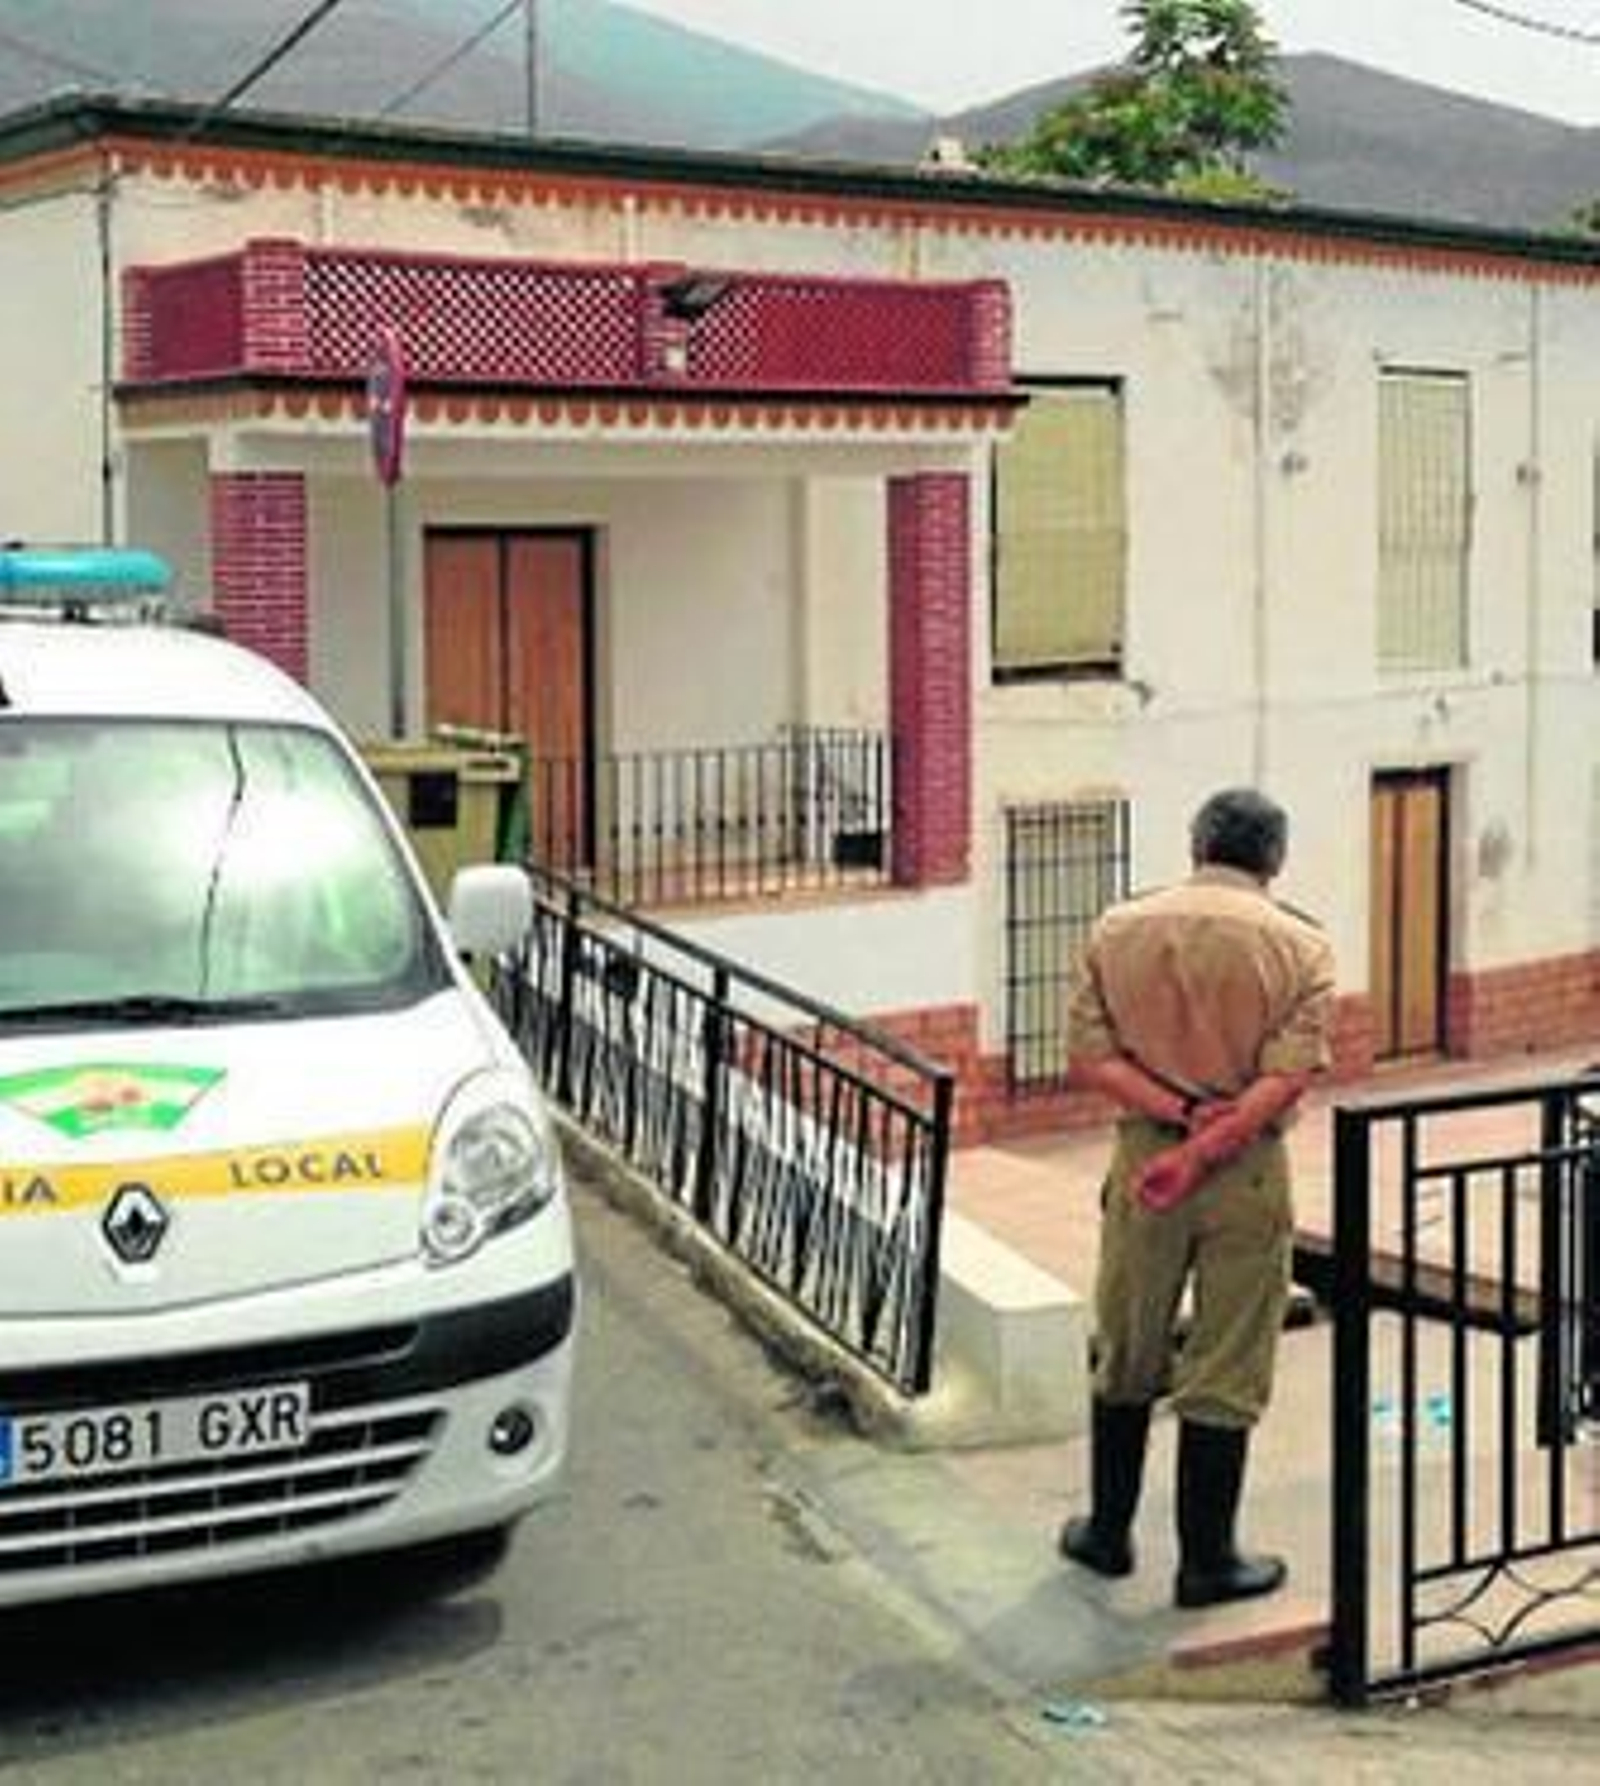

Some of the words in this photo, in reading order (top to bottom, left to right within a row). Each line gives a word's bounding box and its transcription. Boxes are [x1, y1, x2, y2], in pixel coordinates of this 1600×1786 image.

[230, 1150, 382, 1188] LOCAL
[21, 1410, 161, 1472] 5081
[200, 1391, 301, 1451] GXR
